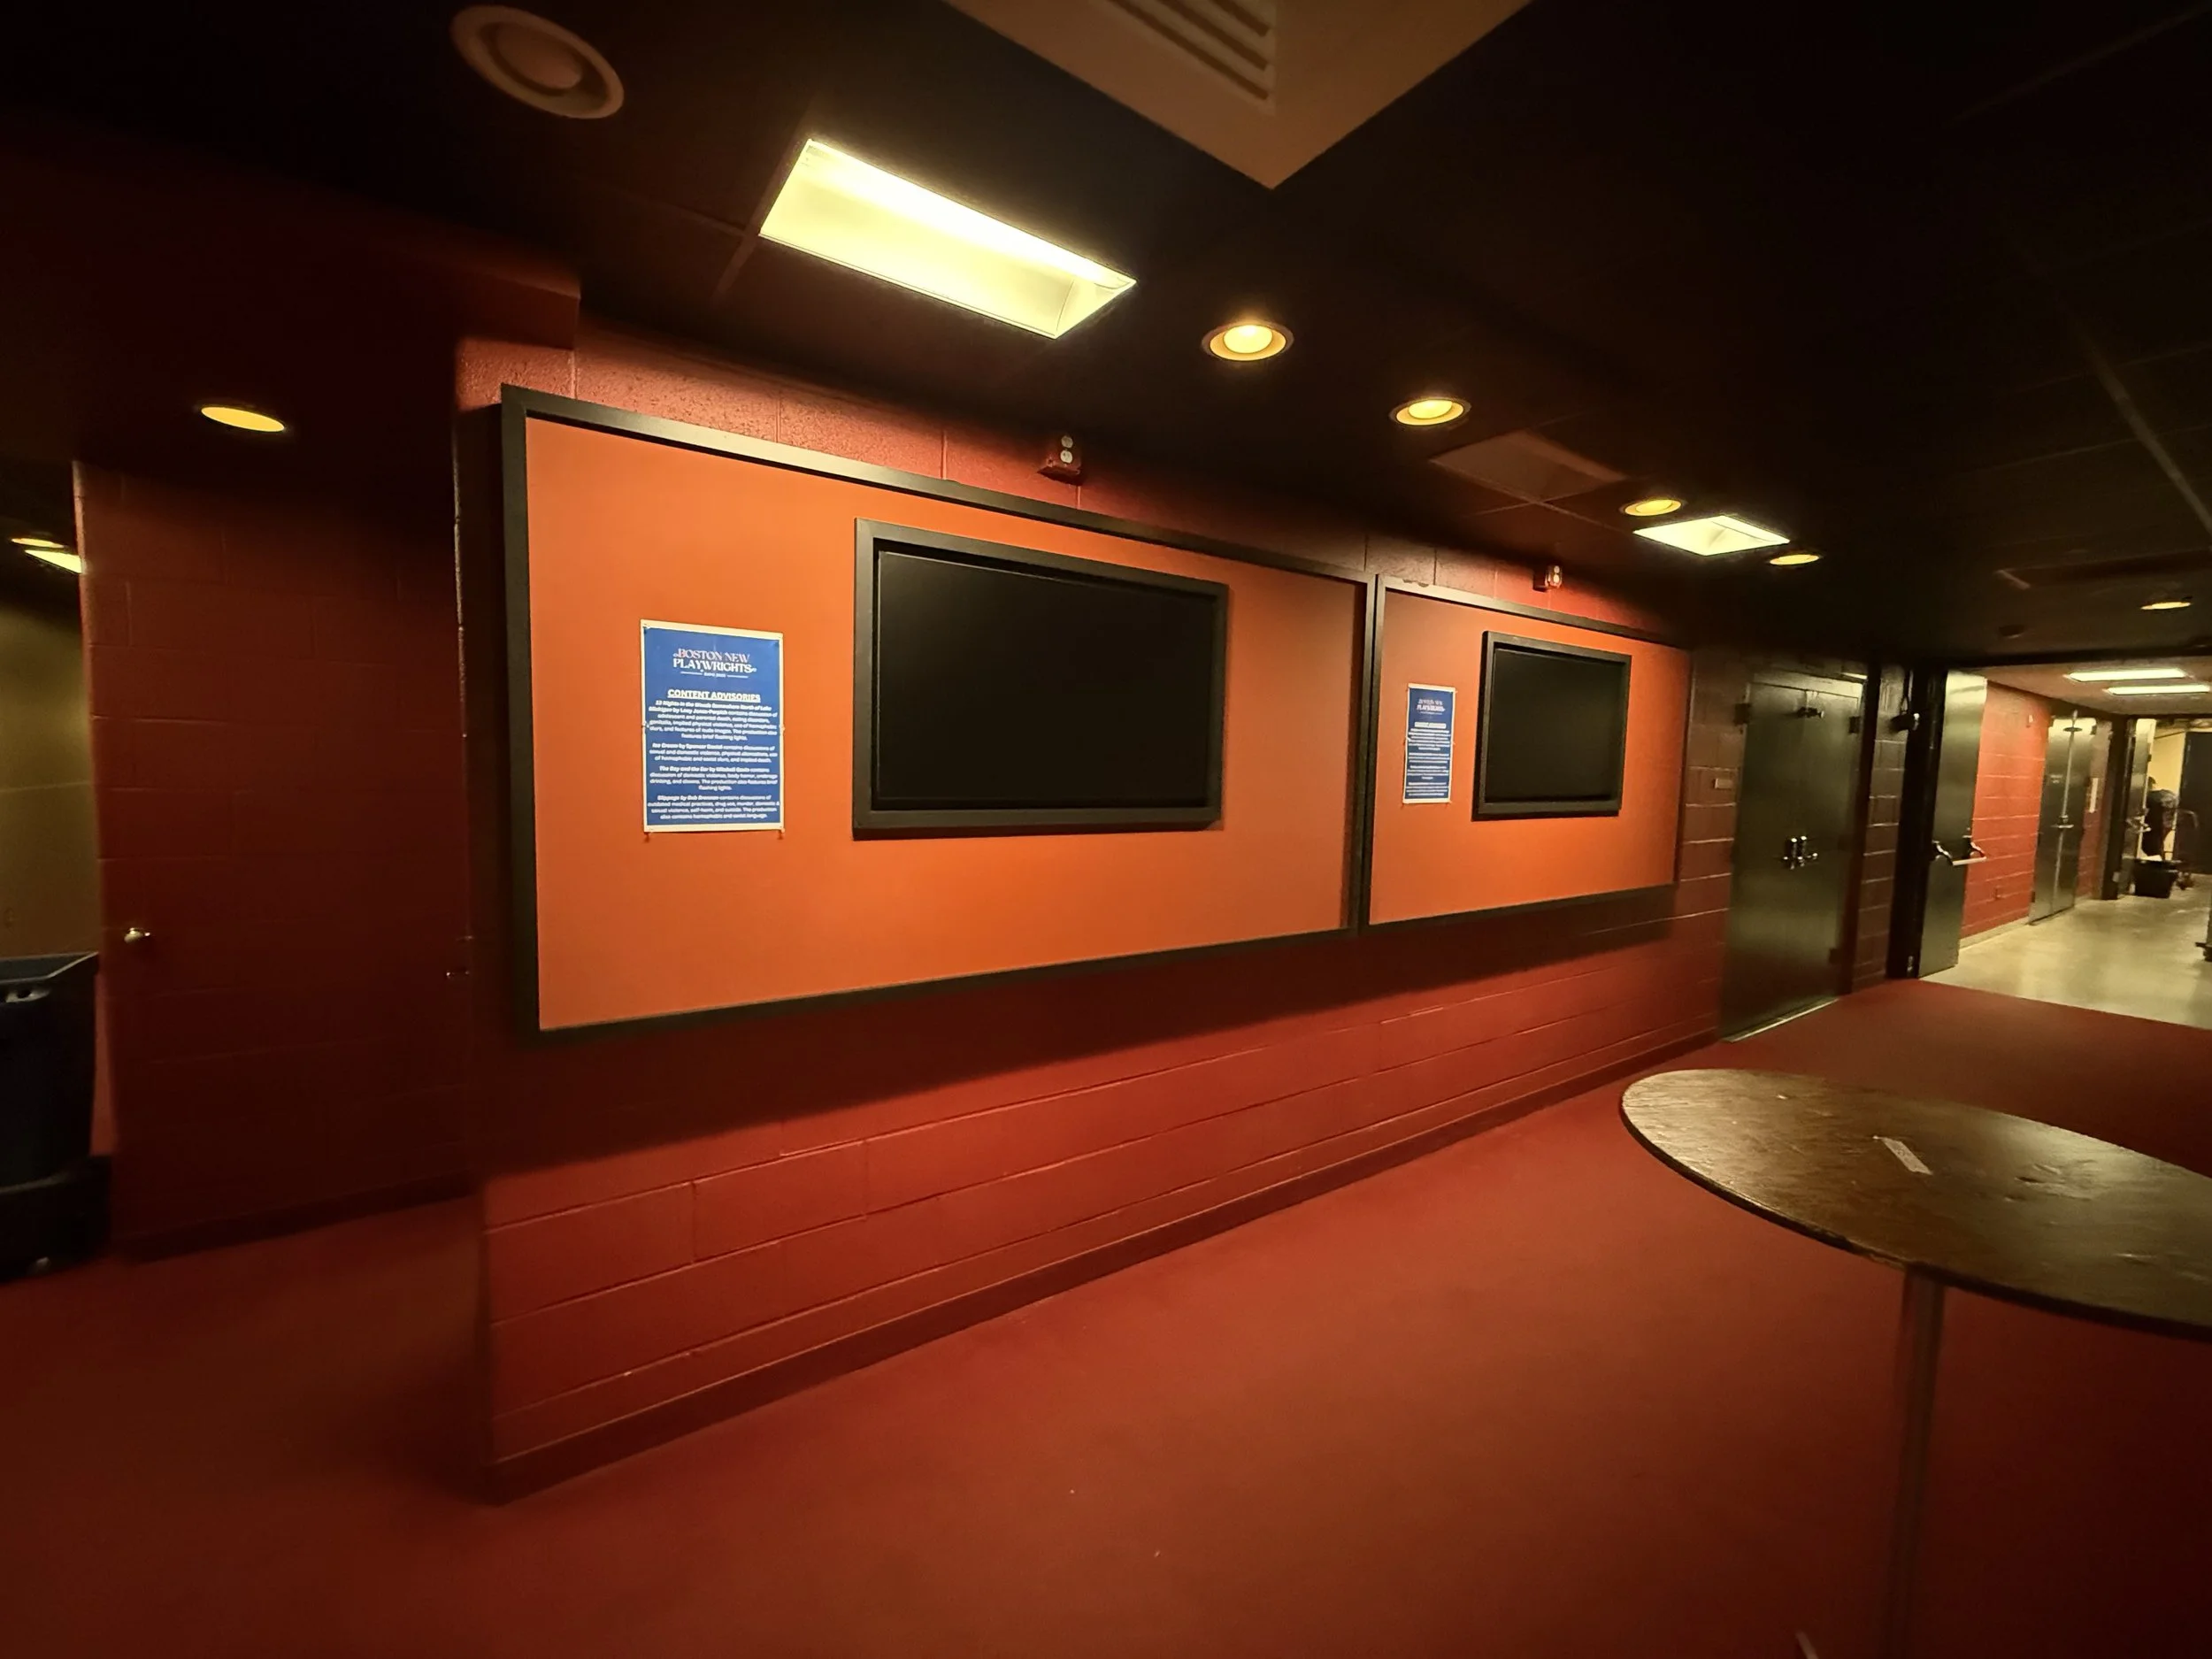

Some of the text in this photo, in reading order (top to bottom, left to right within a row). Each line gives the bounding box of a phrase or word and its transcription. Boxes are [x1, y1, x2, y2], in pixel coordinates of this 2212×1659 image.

[672, 648, 749, 663] BOSTON NEW
[672, 657, 757, 673] PLAYWRIGHTS
[667, 688, 761, 702] CONTENT ADVISORIES
